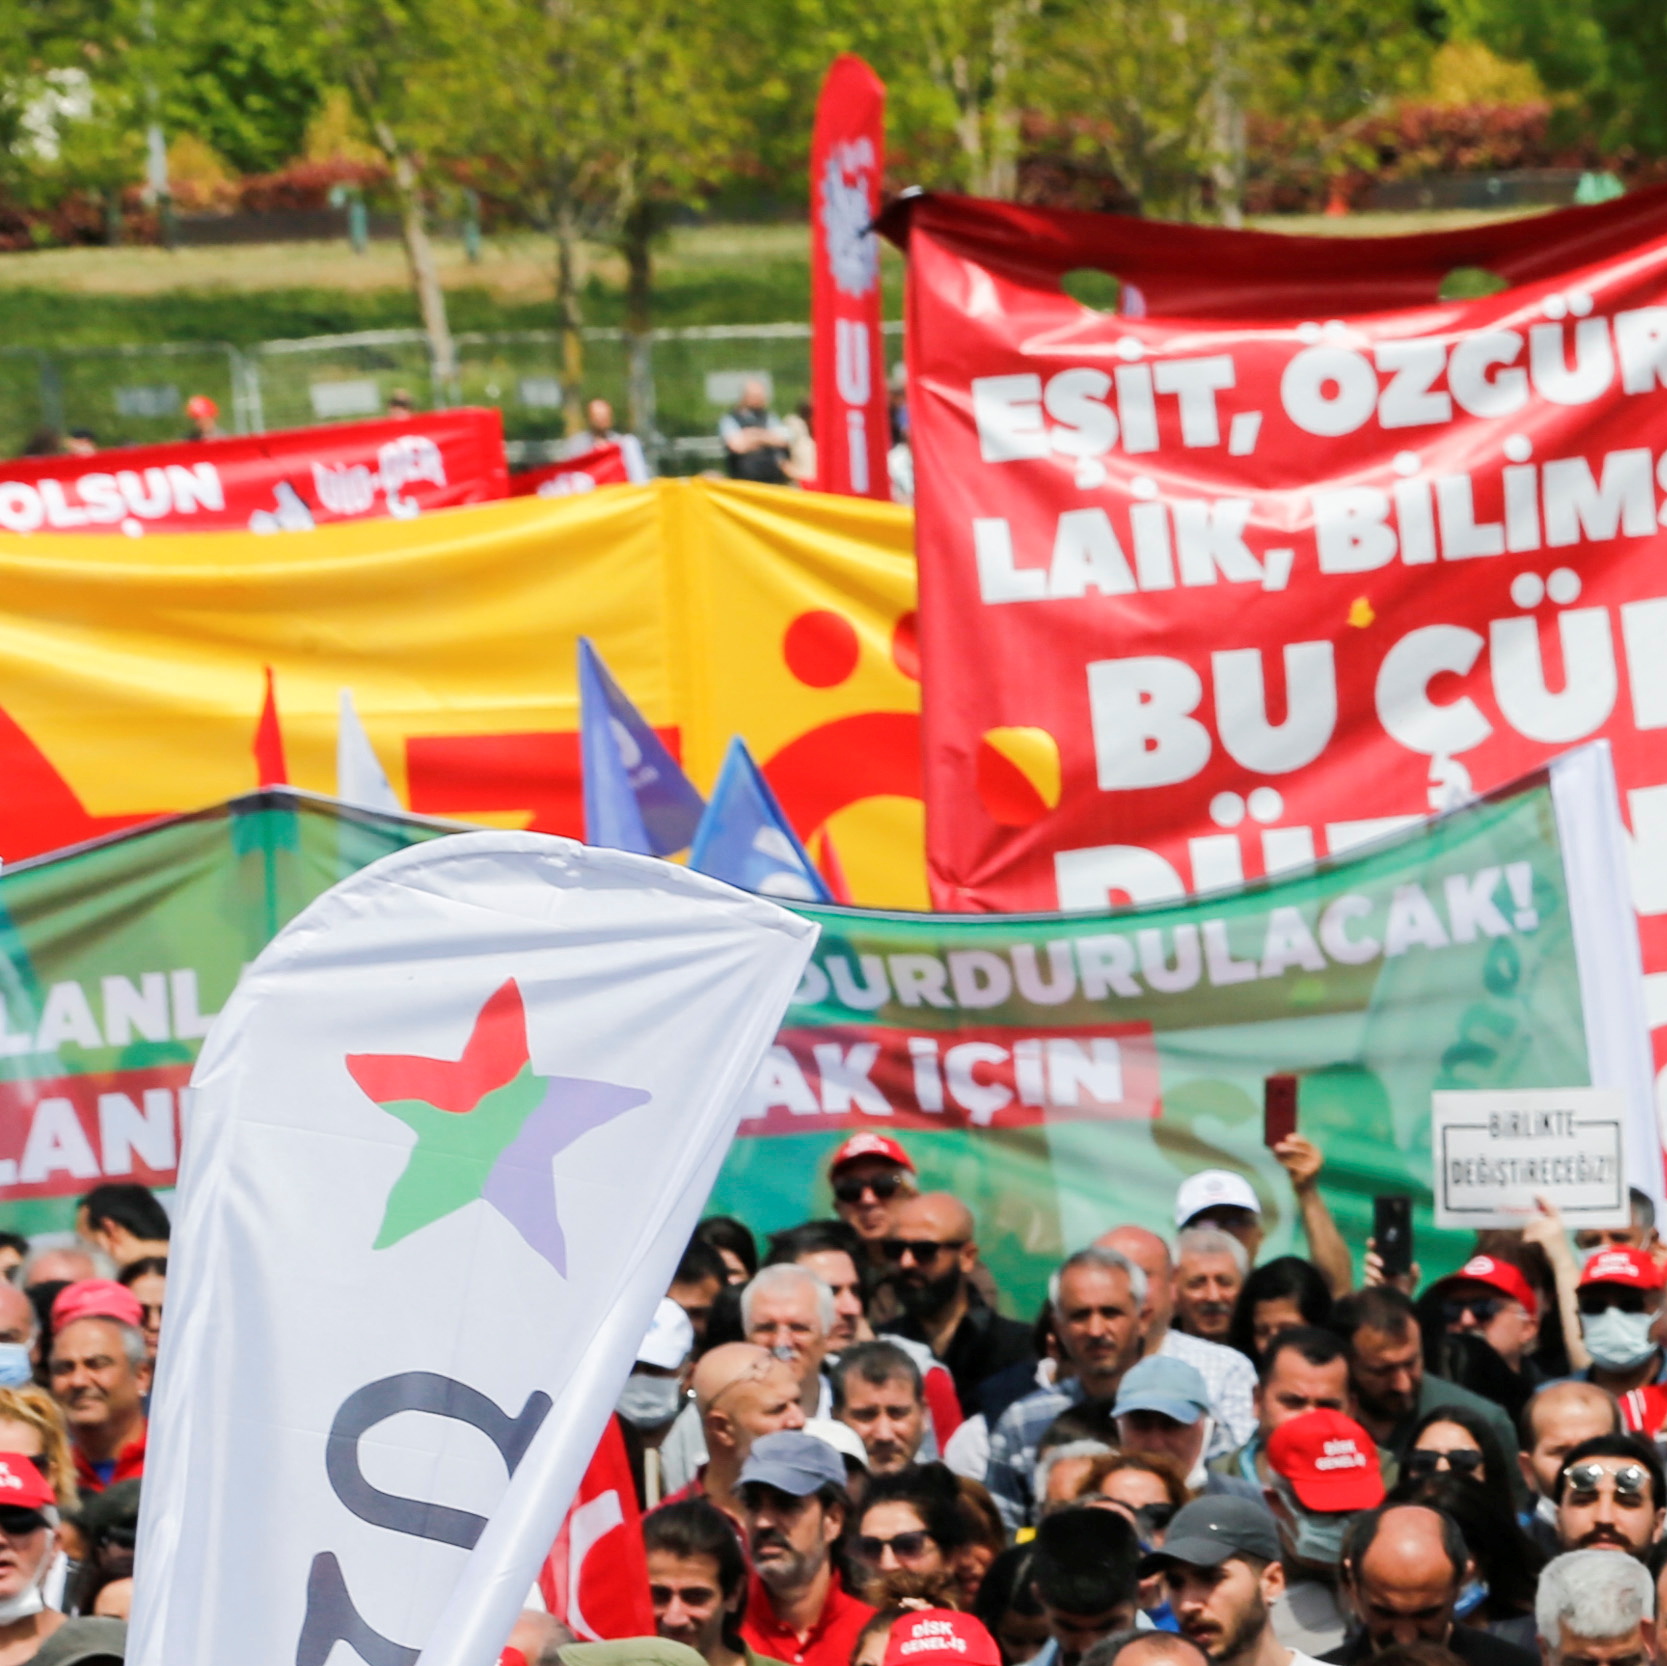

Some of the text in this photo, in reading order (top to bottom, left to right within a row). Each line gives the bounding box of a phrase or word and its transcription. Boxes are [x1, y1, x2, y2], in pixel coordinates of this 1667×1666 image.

[972, 338, 1262, 490] EŞİT,
[972, 478, 1295, 605] LAİK,
[1087, 641, 1339, 791] BU
[911, 1036, 1126, 1130] İÇİN
[900, 1633, 967, 1655] GENEL-İŞ
[911, 1619, 954, 1638] DİSK
